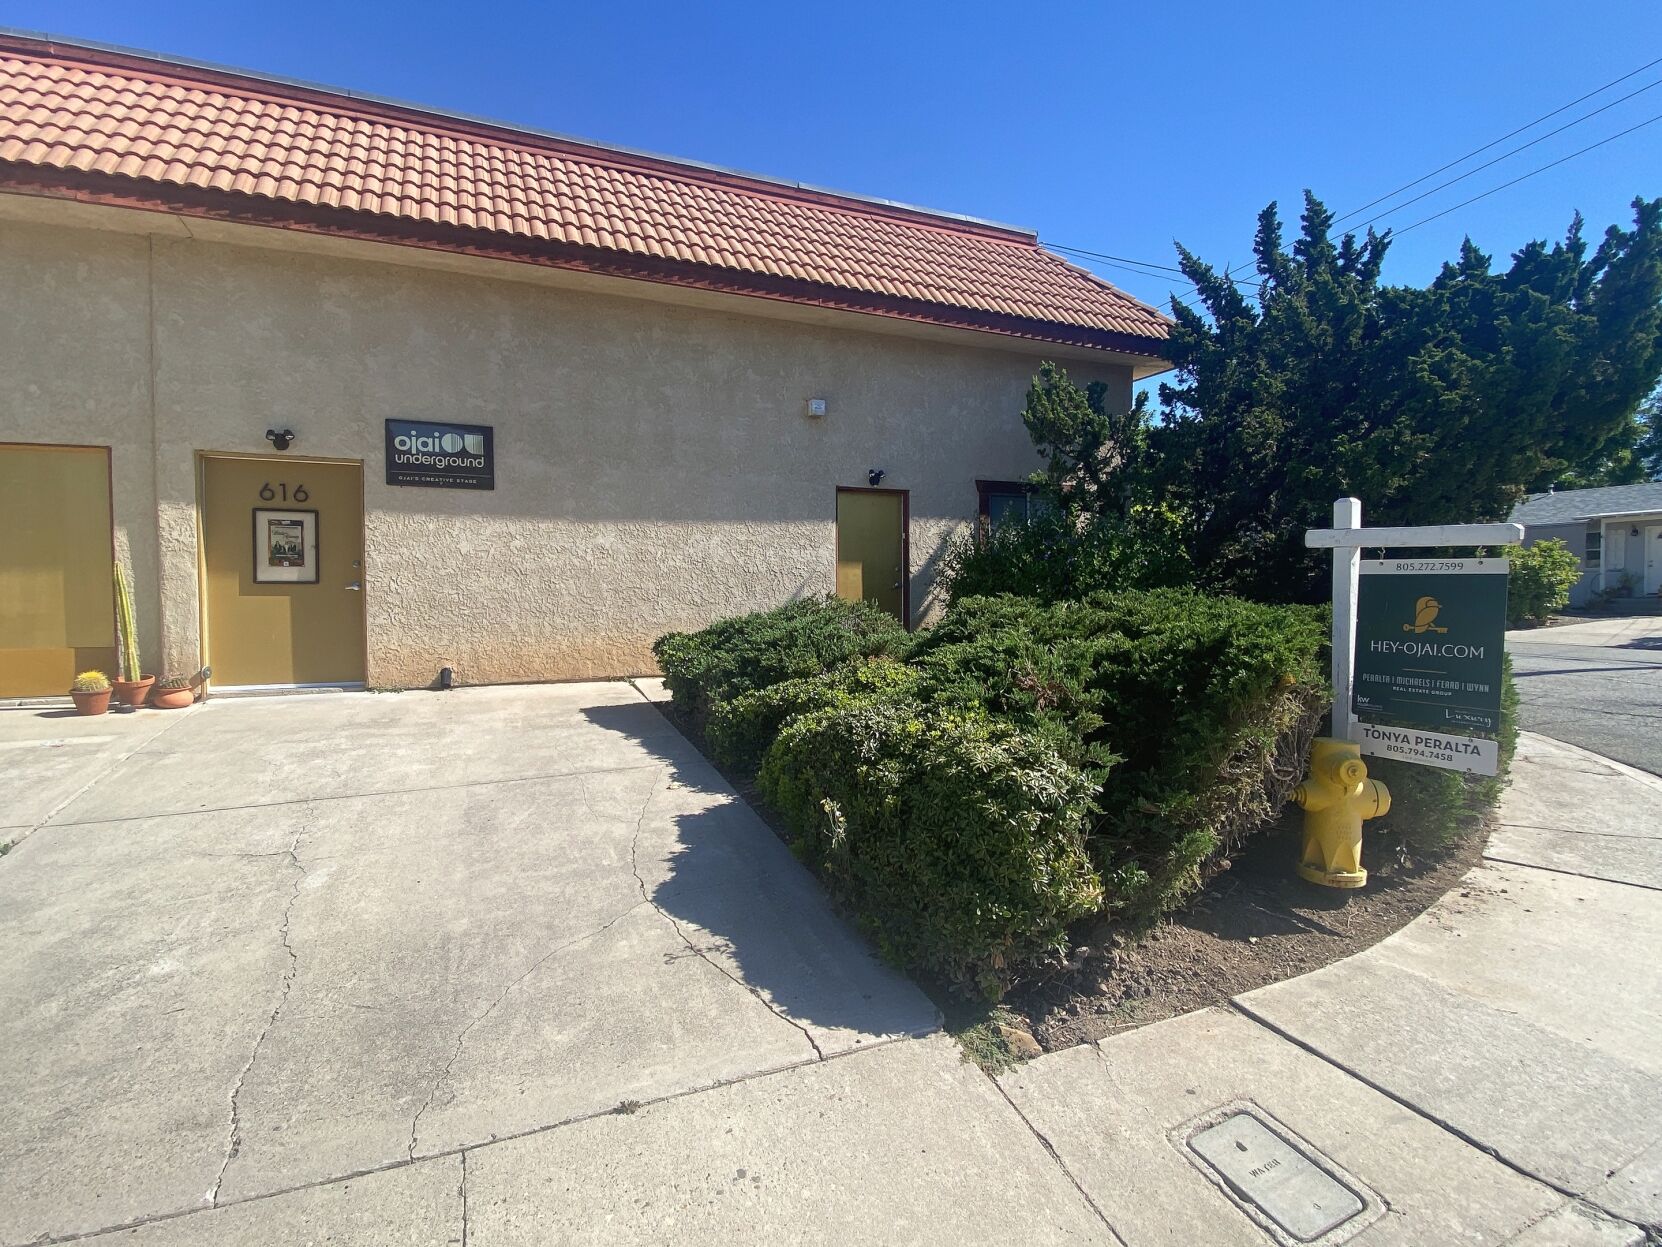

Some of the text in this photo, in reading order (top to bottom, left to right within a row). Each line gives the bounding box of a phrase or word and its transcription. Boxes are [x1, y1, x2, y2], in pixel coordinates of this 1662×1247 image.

[394, 430, 440, 454] ojai
[395, 453, 484, 469] underground
[260, 483, 309, 502] 616
[1396, 562, 1464, 571] 805.272.7599
[1371, 640, 1484, 659] HEY-OJAI.COM
[1362, 673, 1390, 683] PERALTA
[1396, 676, 1430, 687] MICHAELS
[1466, 683, 1489, 693] WYNN
[1445, 708, 1491, 727] Luxury
[1363, 728, 1481, 756] TONYA PERALTA
[1386, 744, 1453, 762] 805.794.7458
